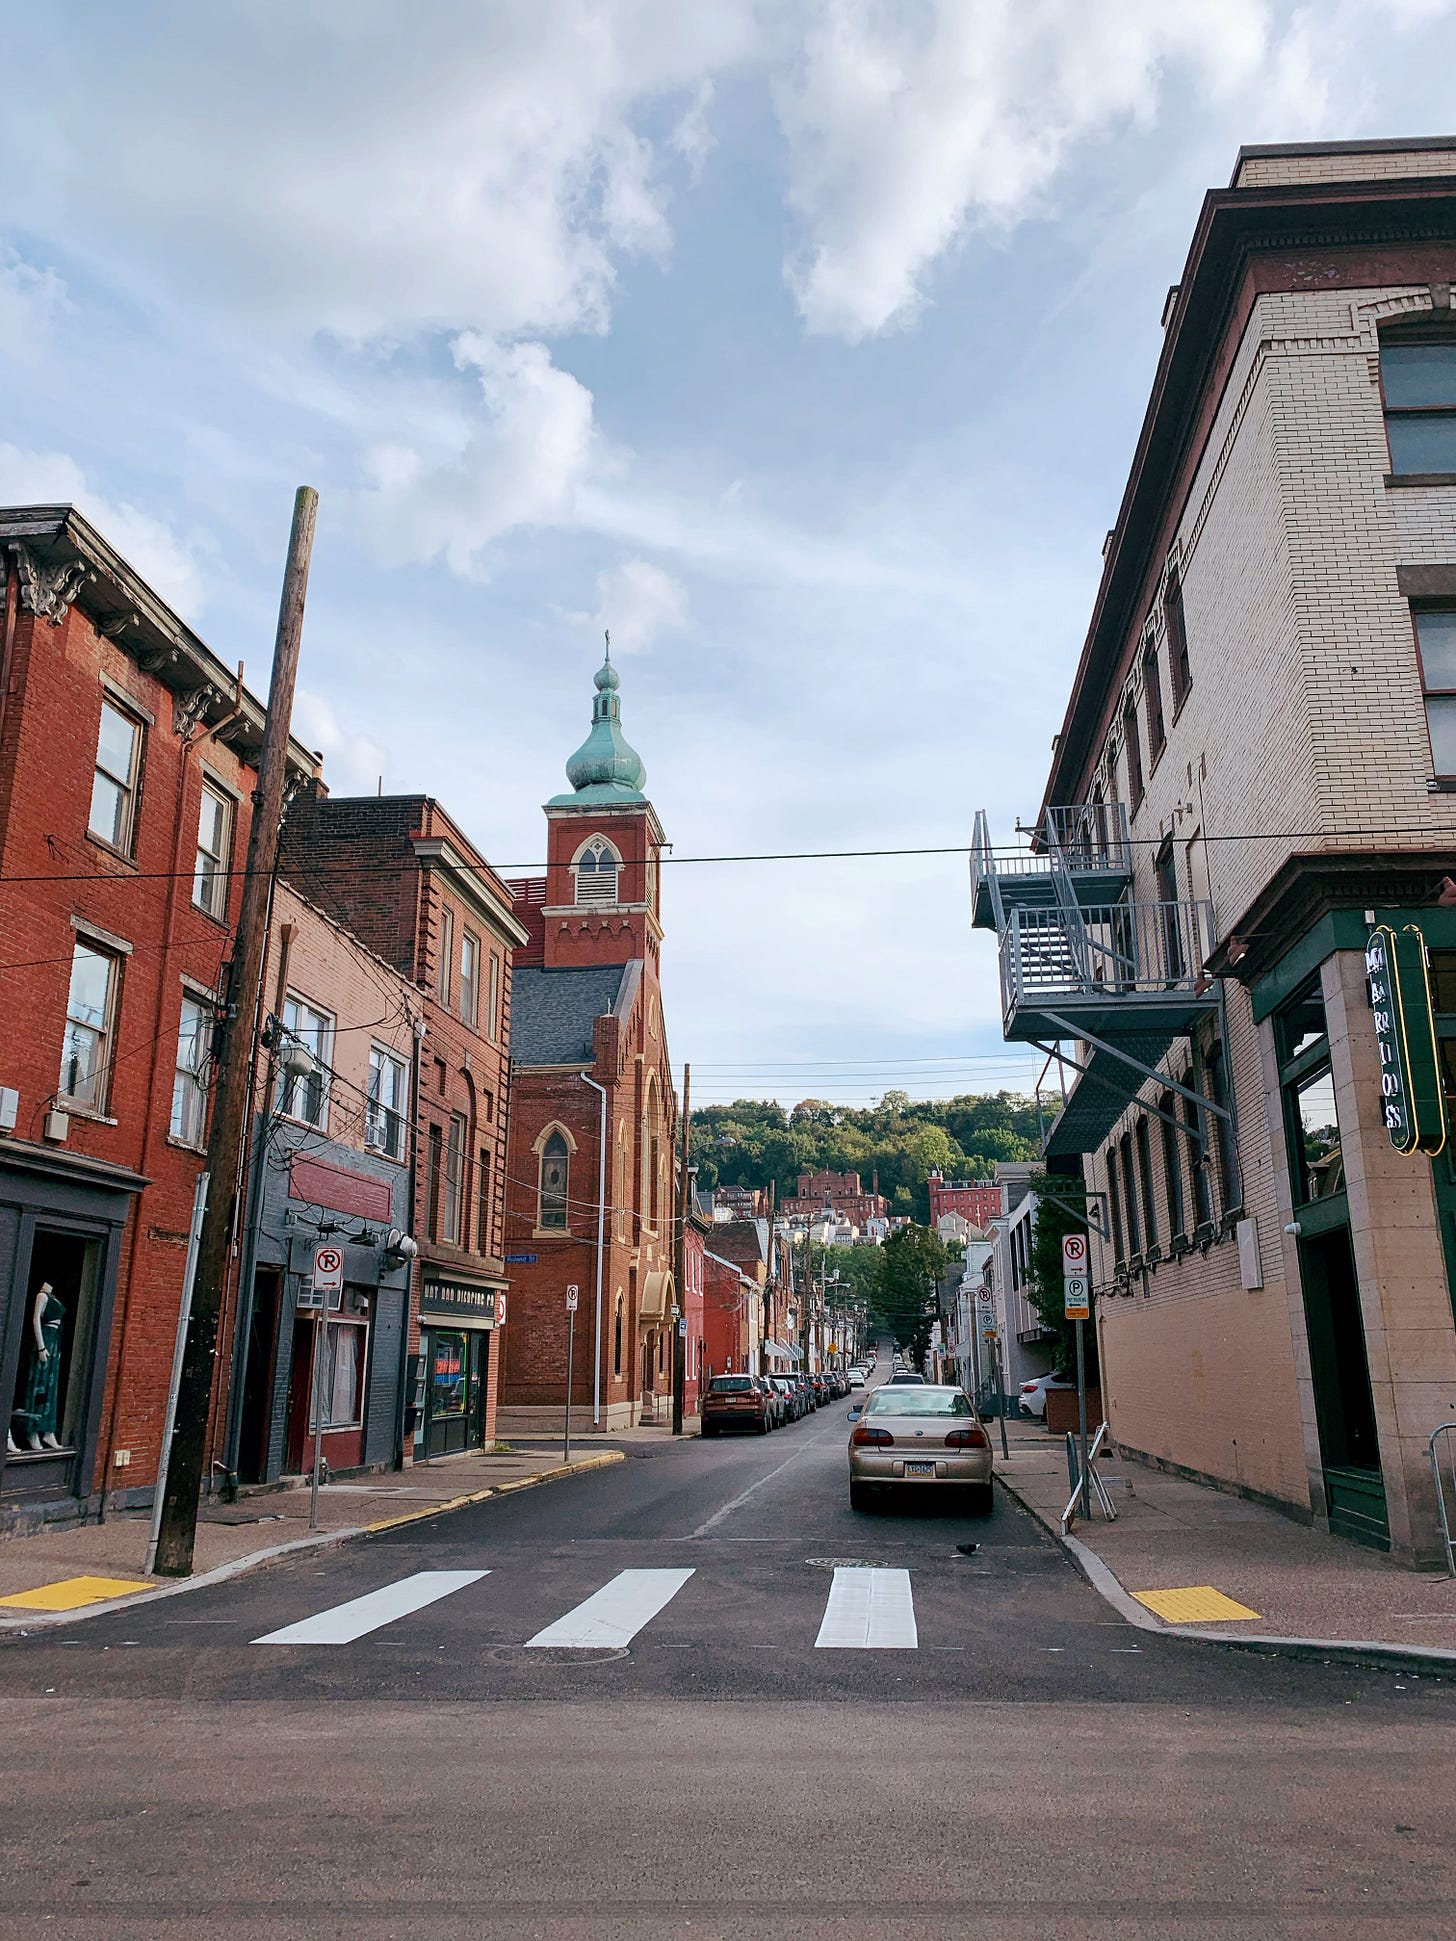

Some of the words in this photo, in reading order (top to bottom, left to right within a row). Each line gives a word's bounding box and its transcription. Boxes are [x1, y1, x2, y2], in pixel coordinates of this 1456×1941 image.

[425, 1284, 438, 1299] HOT
[441, 1287, 454, 1300] ROD
[1073, 1283, 1080, 1293] P
